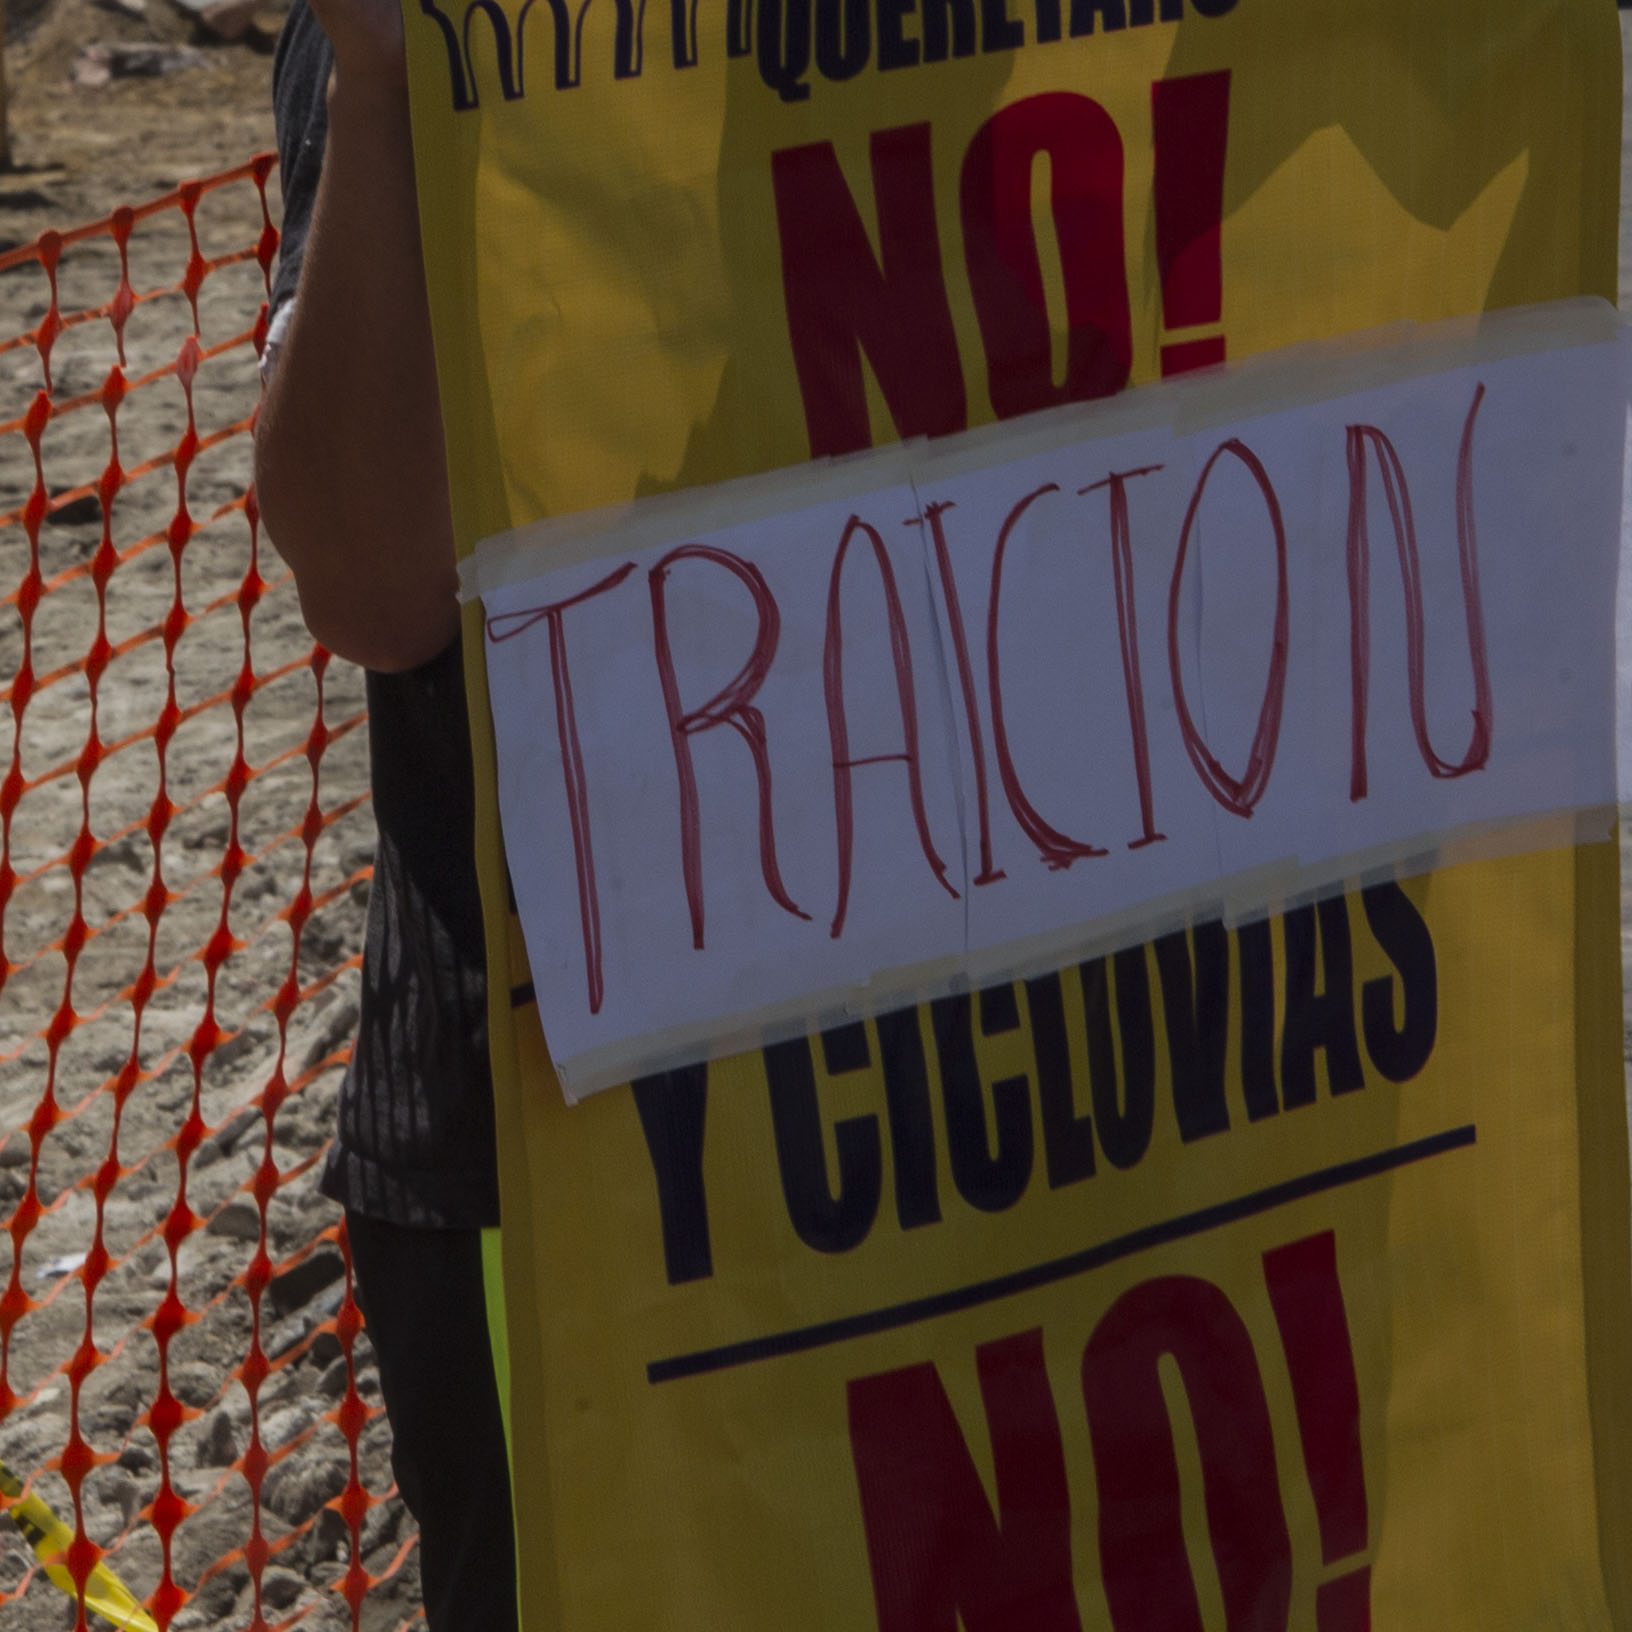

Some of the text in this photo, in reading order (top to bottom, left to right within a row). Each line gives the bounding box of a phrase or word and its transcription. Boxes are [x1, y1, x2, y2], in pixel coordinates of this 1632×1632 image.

[770, 68, 1232, 459] NO!
[484, 382, 1493, 1016] TRAICION
[766, 848, 1440, 1255] CICLOVIAS
[846, 1228, 1371, 1632] NO!
